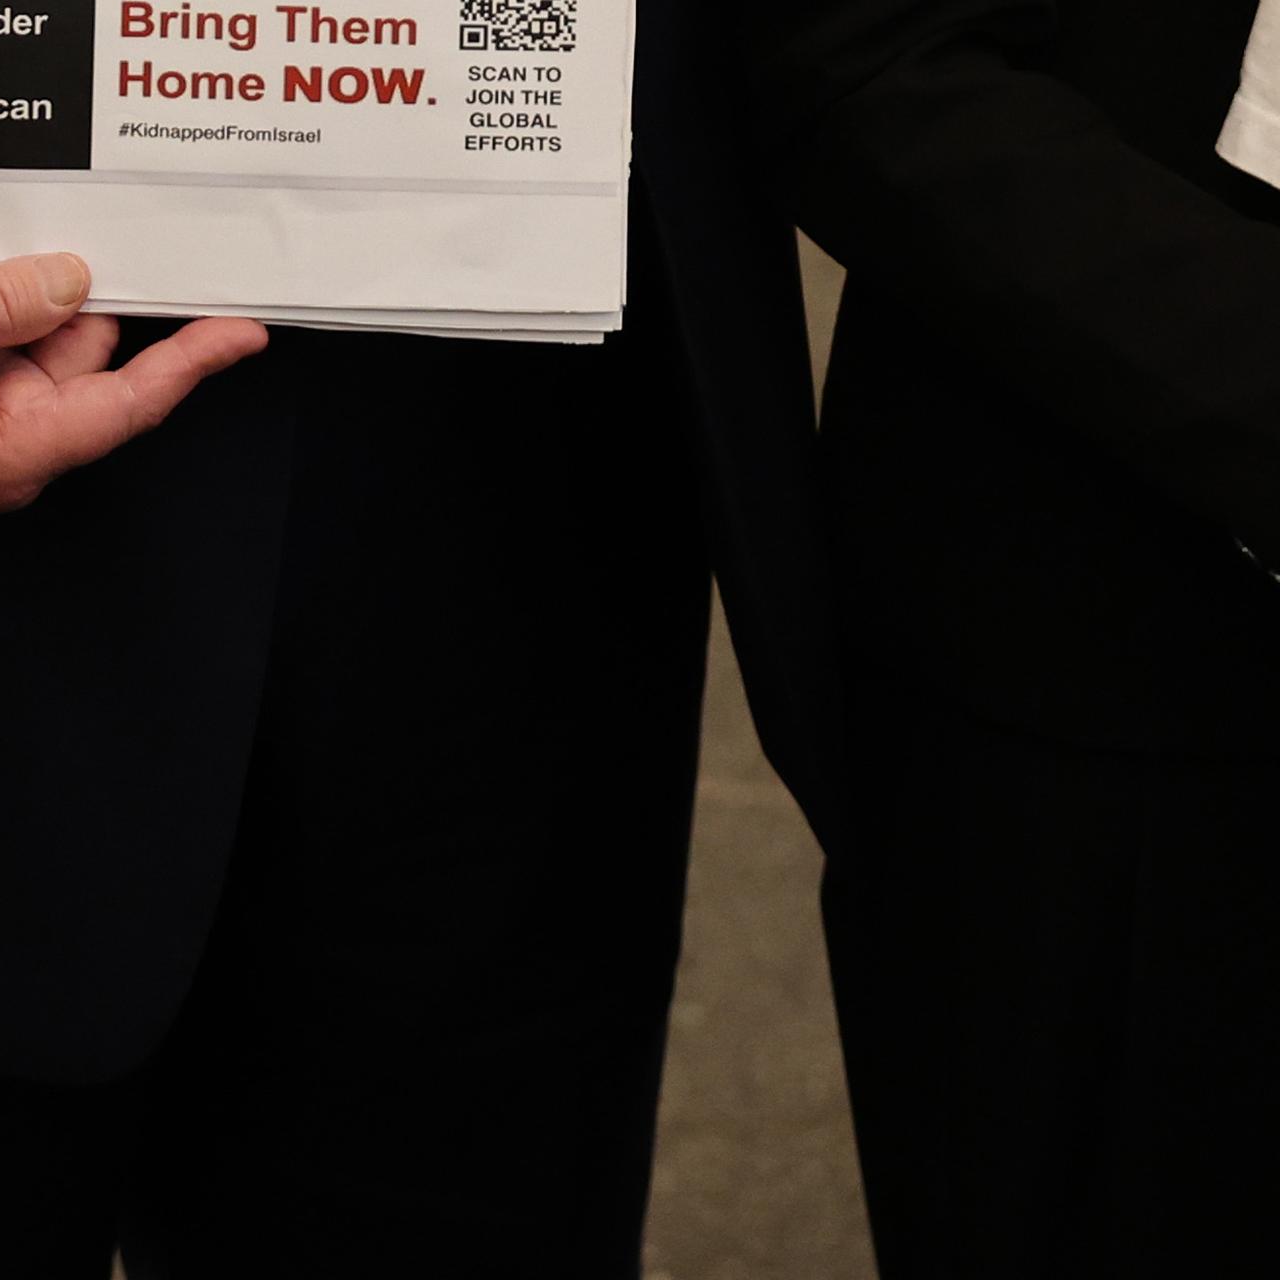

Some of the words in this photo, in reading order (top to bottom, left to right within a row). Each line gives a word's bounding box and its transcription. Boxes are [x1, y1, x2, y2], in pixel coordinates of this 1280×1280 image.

[120, 0, 257, 51] Bring
[276, 5, 418, 45] Them
[118, 61, 265, 101] Home
[283, 65, 438, 106] NOW.
[468, 65, 527, 82] SCAN
[532, 66, 562, 83] TO
[465, 88, 515, 106] JOIN
[520, 89, 562, 106] THE
[469, 111, 558, 129] GLOBAL
[118, 122, 321, 145] #KidnappedFromIsrael
[464, 134, 562, 153] EFFORTS
